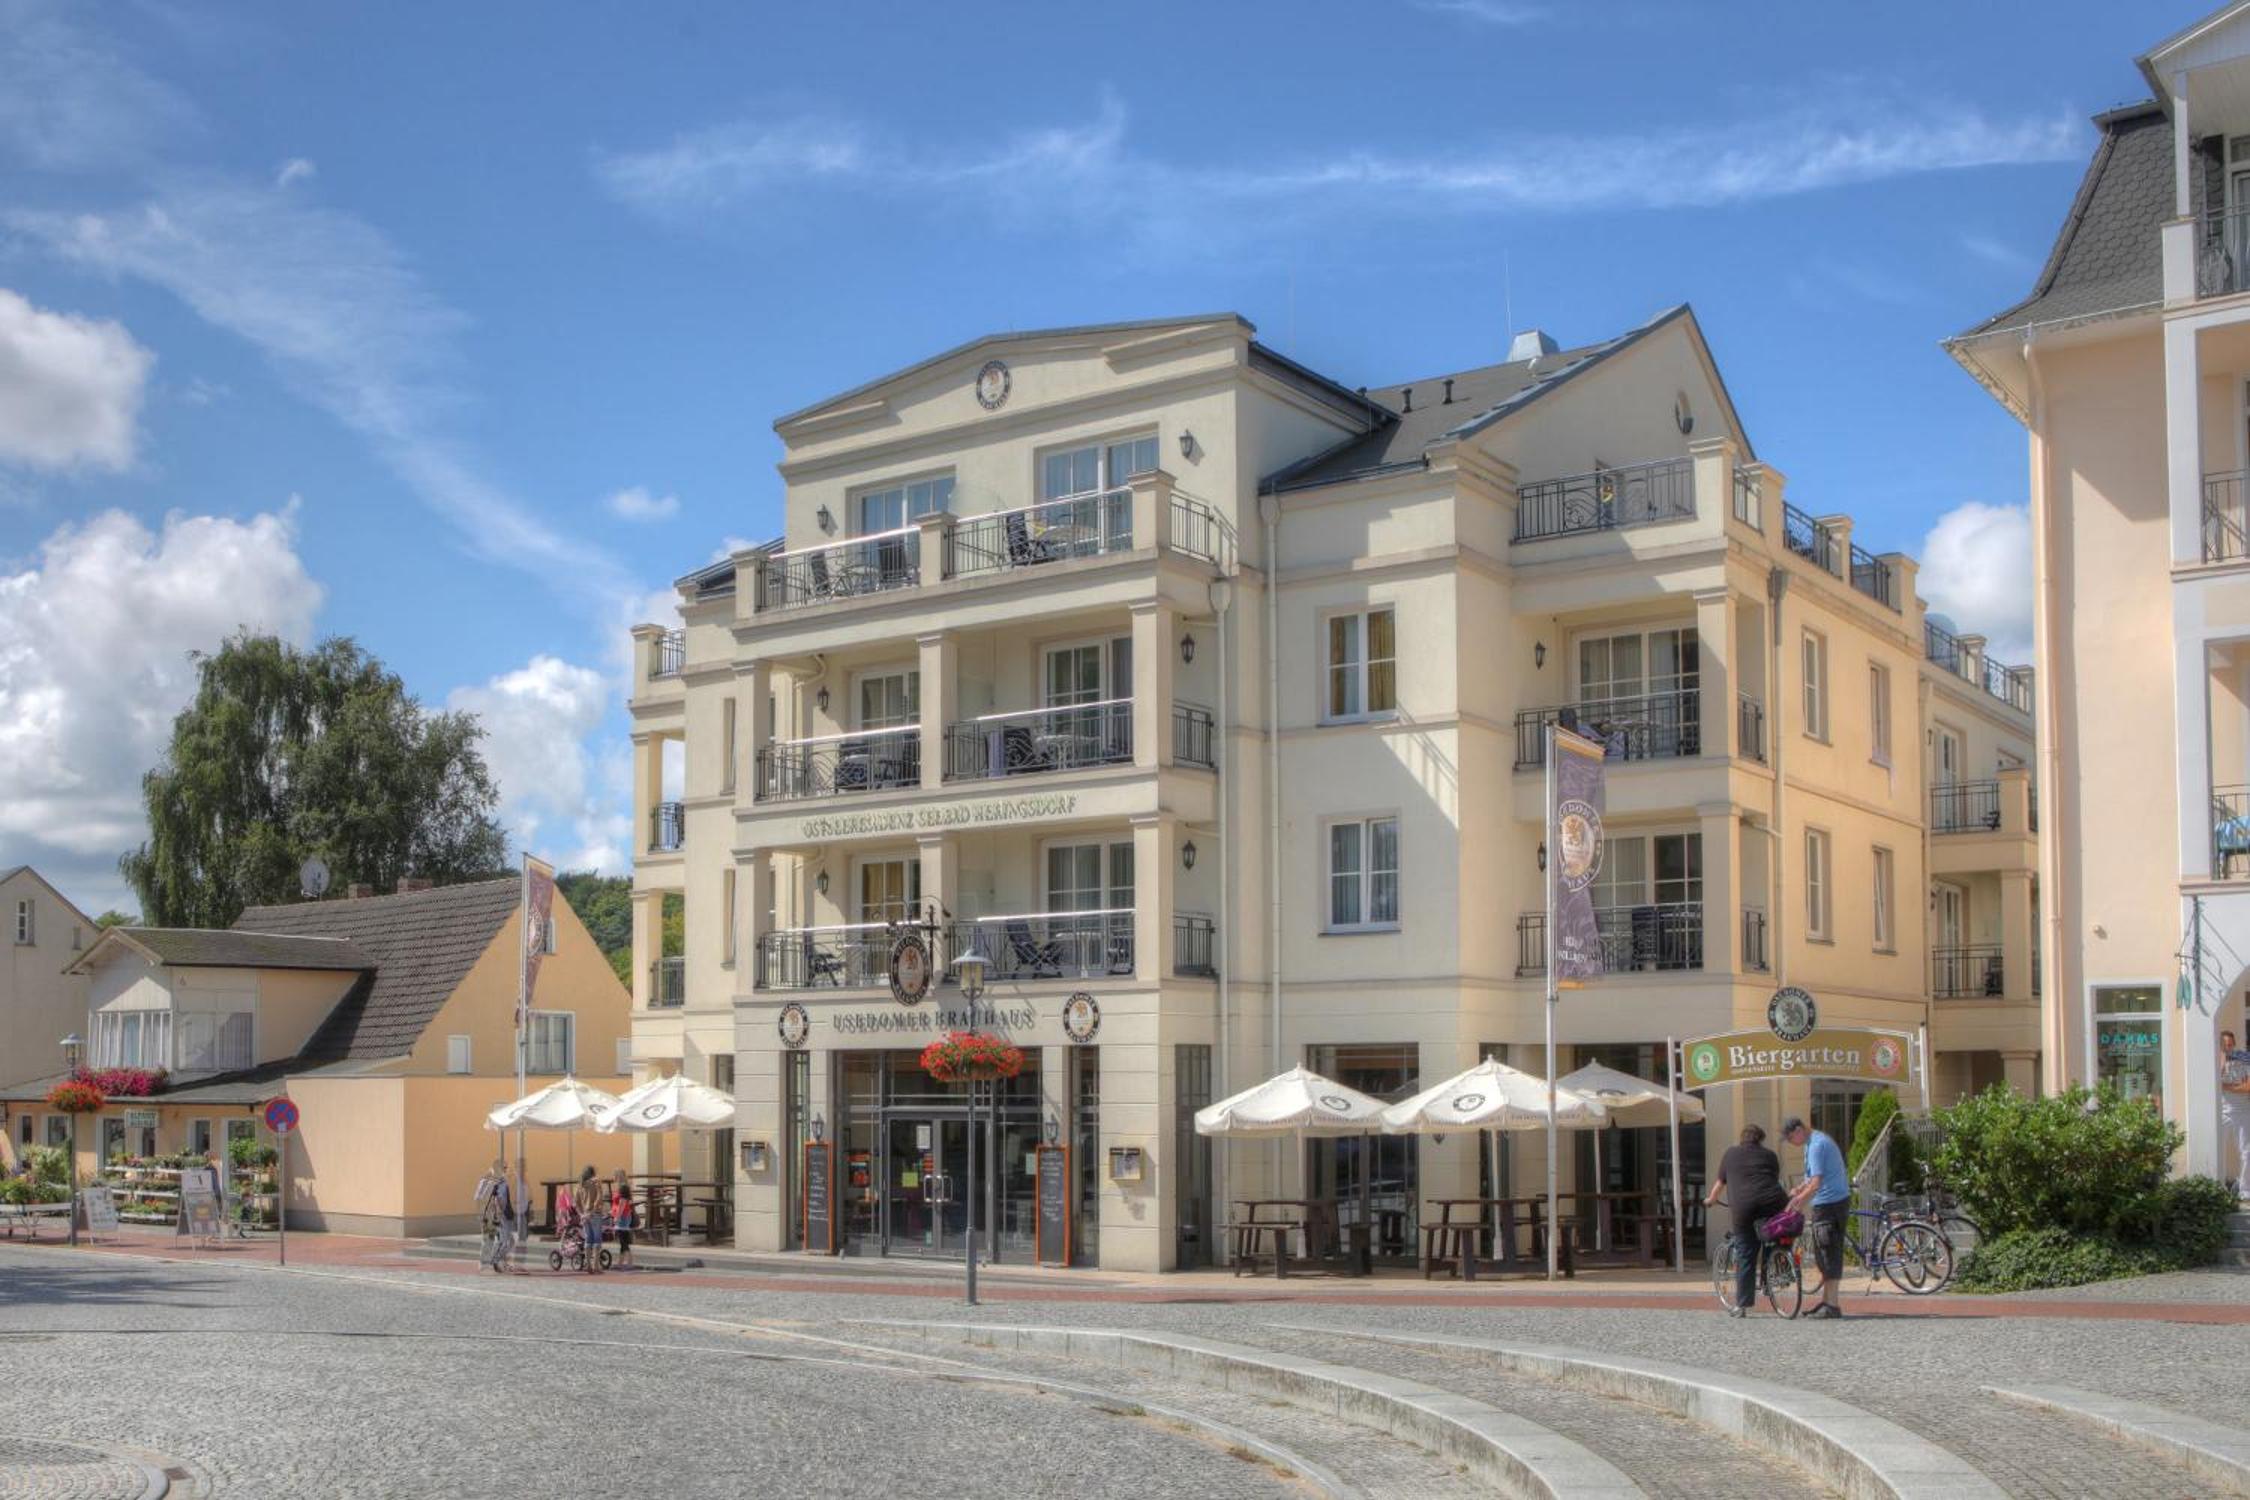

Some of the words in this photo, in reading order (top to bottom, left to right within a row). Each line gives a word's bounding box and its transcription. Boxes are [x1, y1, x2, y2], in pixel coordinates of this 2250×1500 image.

[917, 804, 971, 827] SEEBAD
[974, 794, 1077, 822] HERINGSDORF
[833, 1010, 929, 1031] USEDOMER
[1728, 1045, 1860, 1071] Biergarten
